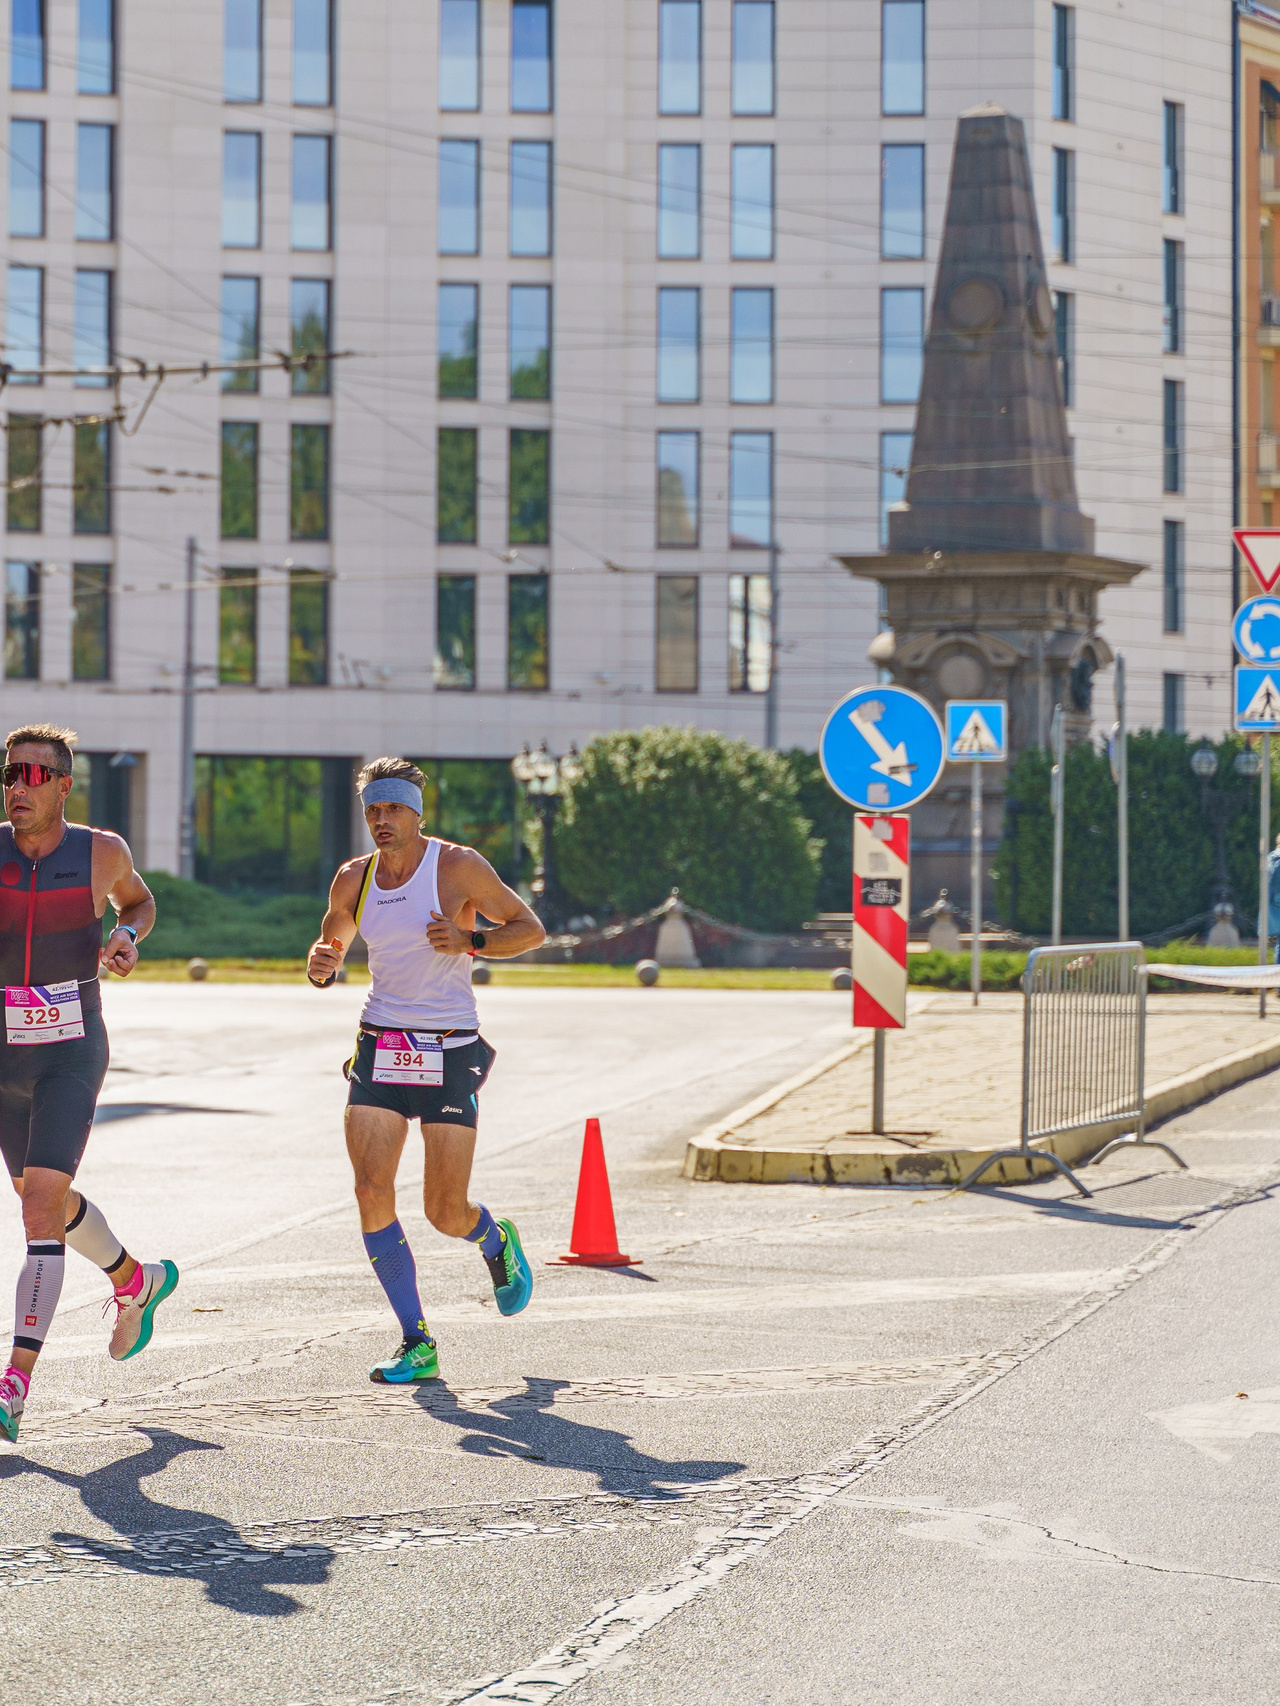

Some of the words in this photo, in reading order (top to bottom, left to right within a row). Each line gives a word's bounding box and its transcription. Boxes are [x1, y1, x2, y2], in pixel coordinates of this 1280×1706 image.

[54, 871, 78, 880] Santini
[377, 896, 407, 905] DIADORA
[23, 1007, 60, 1025] 329
[393, 1052, 424, 1067] 394
[30, 1260, 44, 1312] COMPRESSPORT
